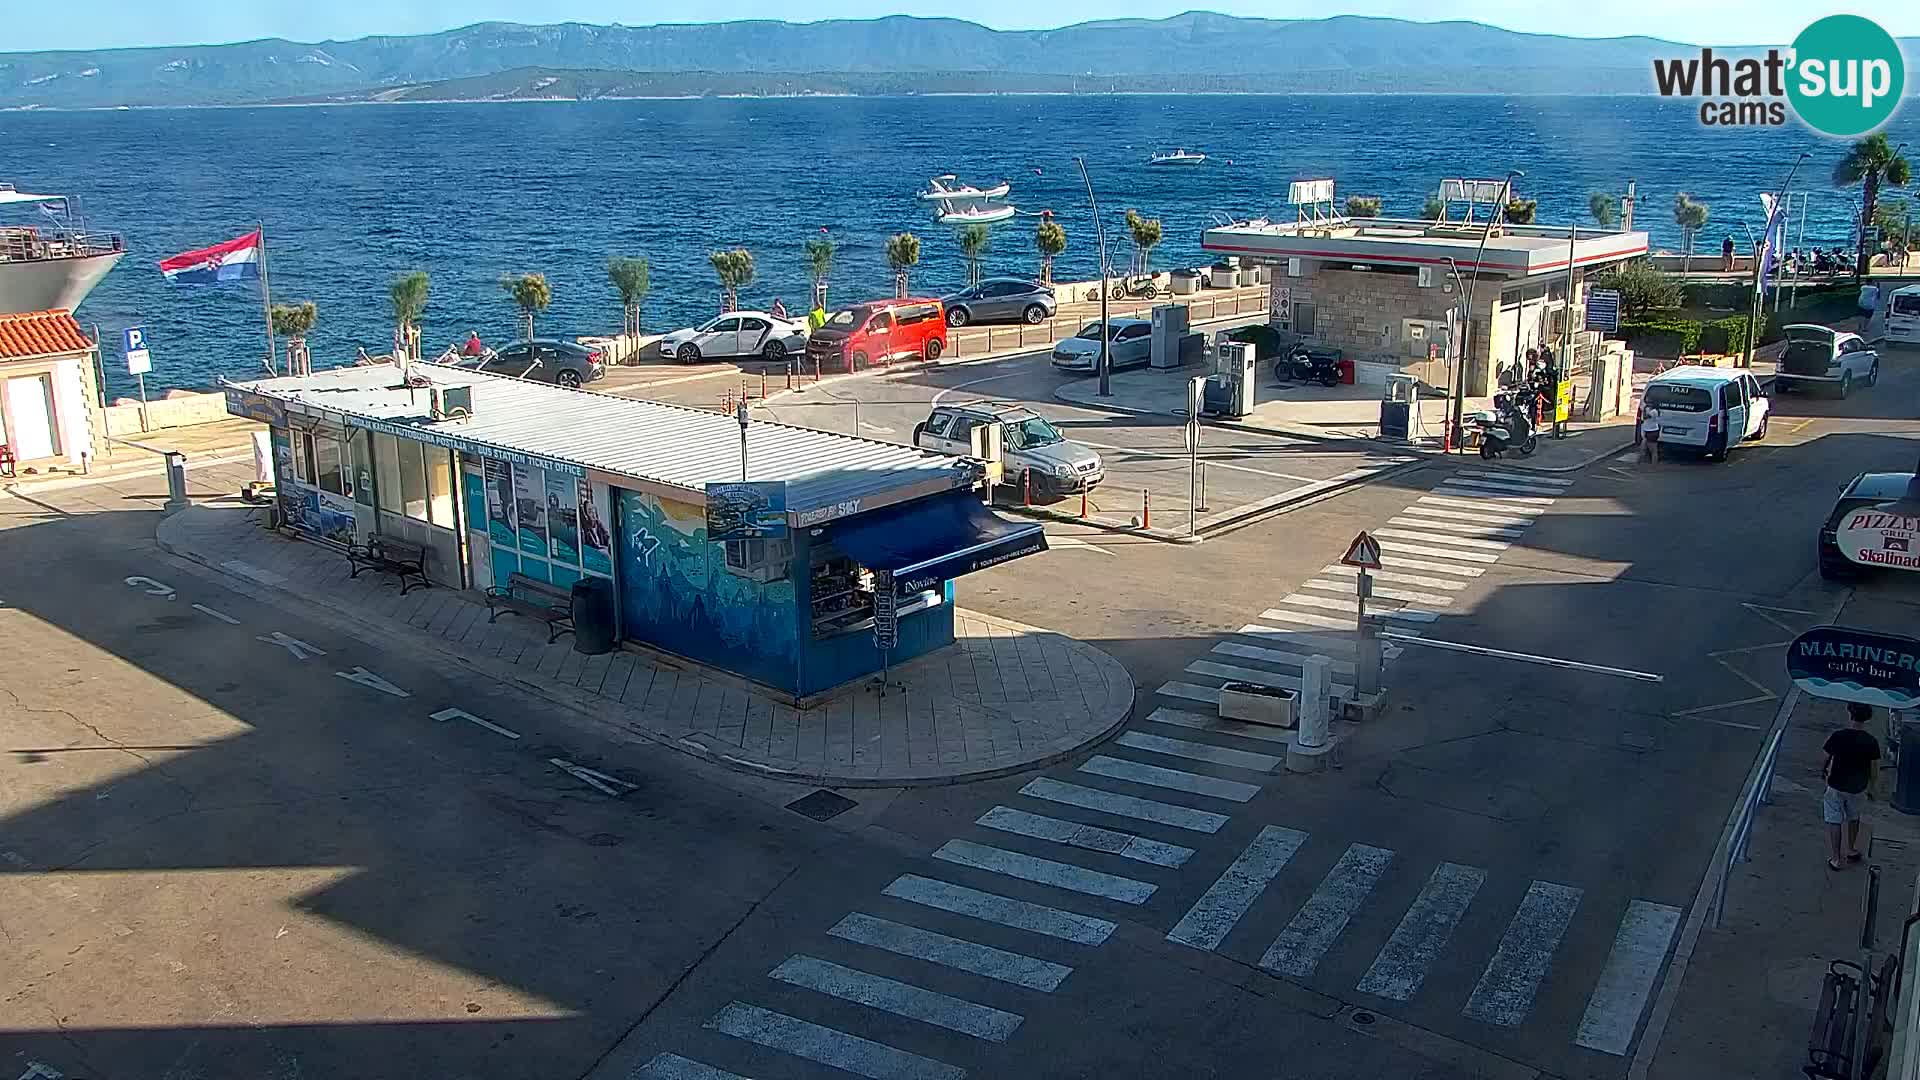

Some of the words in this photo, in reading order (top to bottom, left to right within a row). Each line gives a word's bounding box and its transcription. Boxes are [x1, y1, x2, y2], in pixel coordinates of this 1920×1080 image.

[128, 330, 142, 349] P
[436, 435, 468, 451] POSTAJA
[477, 446, 493, 457] BUS
[494, 448, 527, 464] STATION
[528, 456, 555, 471] TICKET
[555, 463, 583, 477] OFFICE
[1880, 529, 1916, 540] GRILL
[1827, 661, 1865, 674] caffe
[1868, 664, 1896, 679] bar
